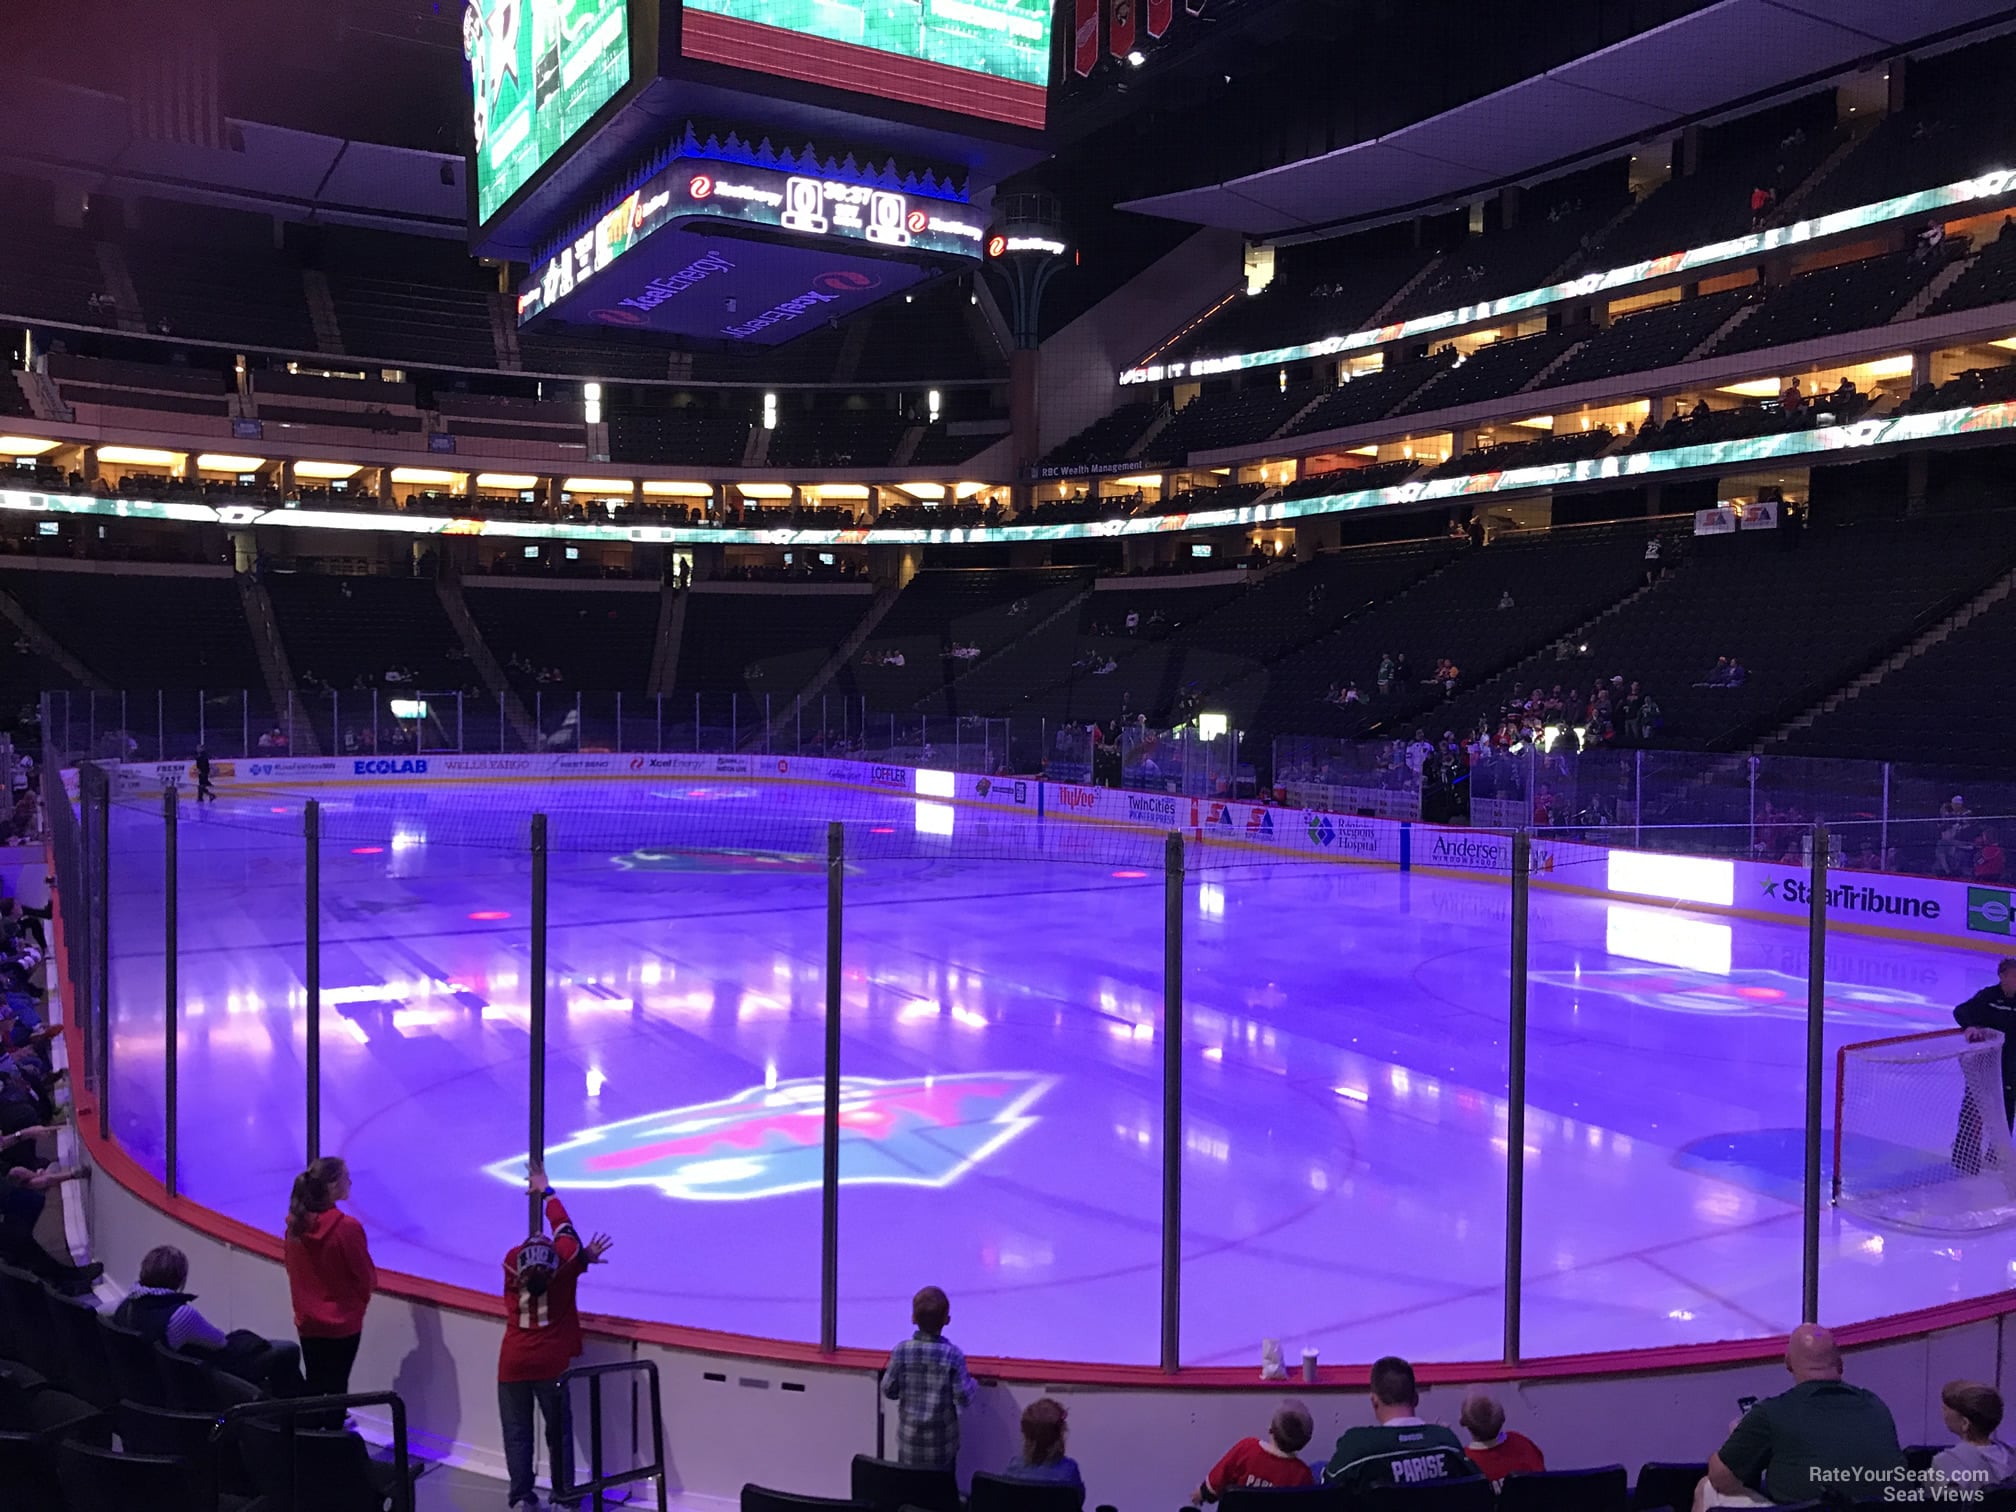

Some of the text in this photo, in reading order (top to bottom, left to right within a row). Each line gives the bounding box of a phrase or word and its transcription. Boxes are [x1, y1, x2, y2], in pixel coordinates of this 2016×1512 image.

[1042, 468, 1058, 477] RBC
[1061, 465, 1089, 476] Wealth
[1091, 461, 1143, 474] Management
[354, 760, 428, 774] ECOLAB
[444, 760, 530, 770] WELLS FARGO
[872, 767, 906, 783] LOFFLER
[1338, 838, 1377, 852] Hospital
[1432, 836, 1506, 859] Andersen
[1391, 1454, 1448, 1483] PARISE
